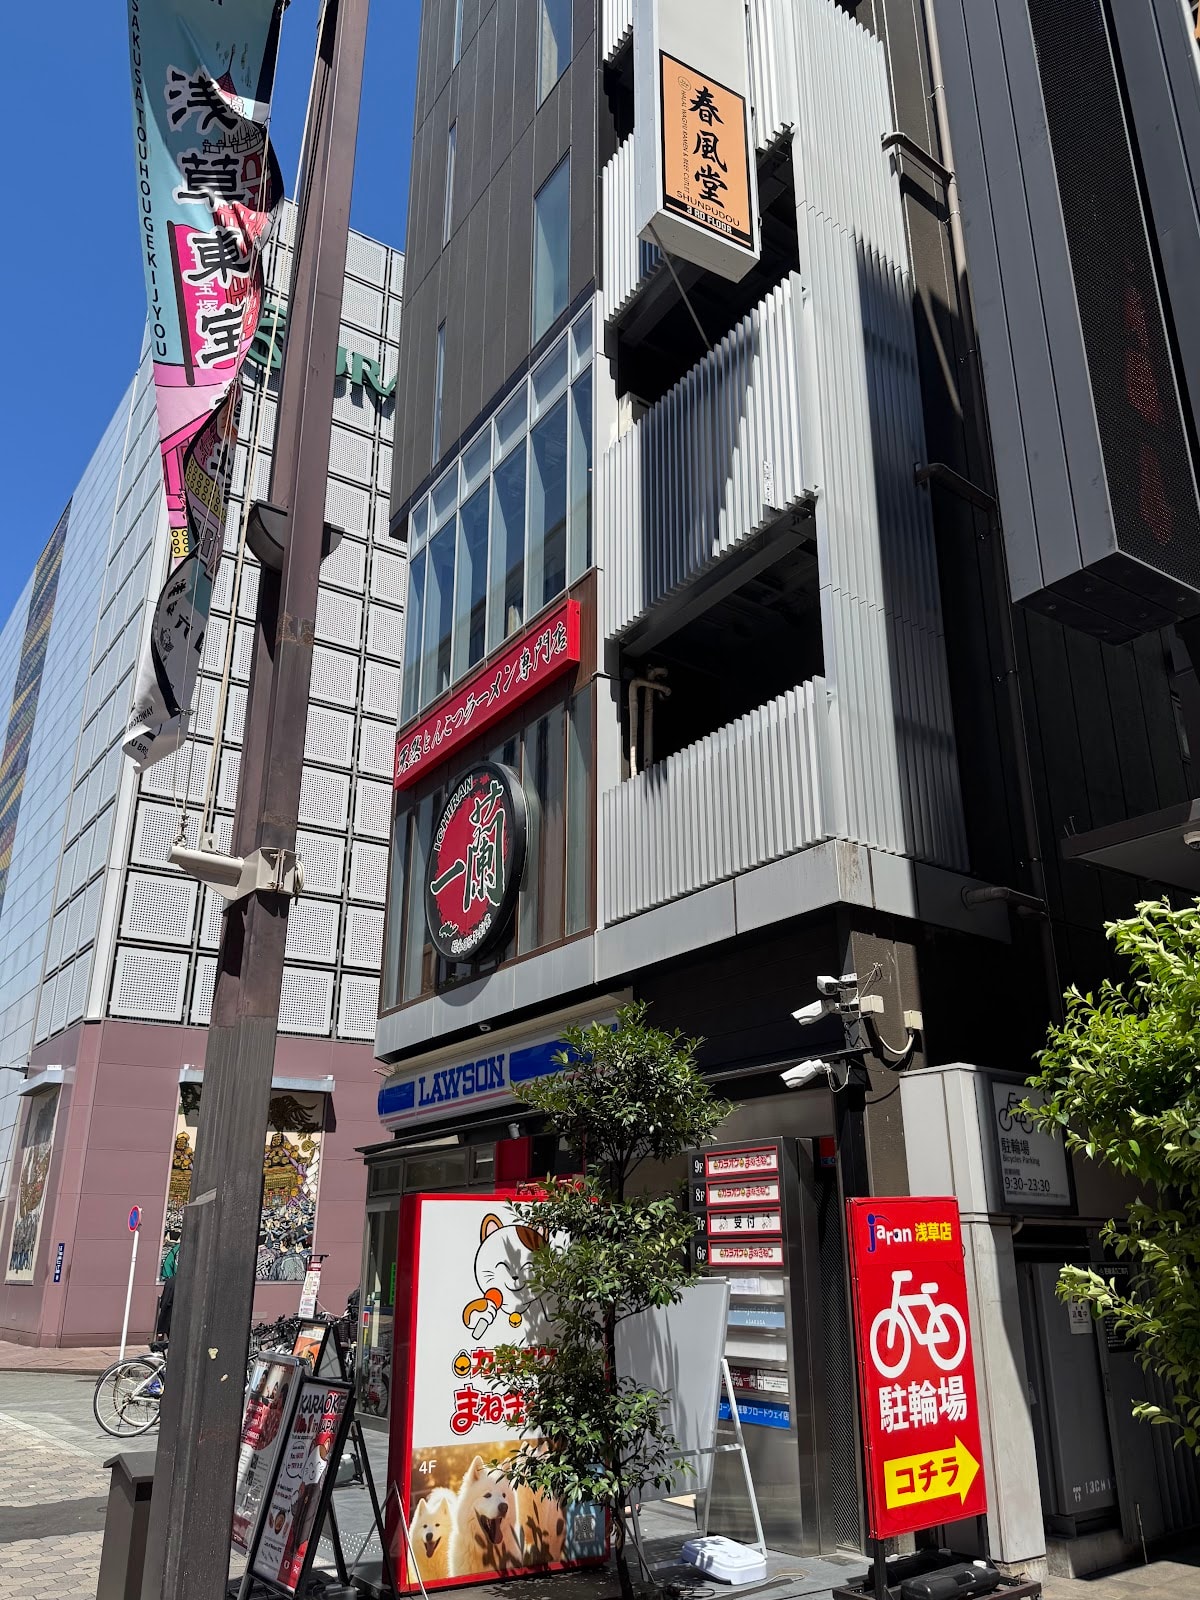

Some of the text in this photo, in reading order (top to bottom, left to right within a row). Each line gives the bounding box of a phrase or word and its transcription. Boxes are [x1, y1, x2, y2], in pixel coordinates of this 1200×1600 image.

[688, 86, 728, 208] 春風堂
[676, 190, 740, 227] SHUNPUDOU
[707, 214, 732, 234] FLOOR
[434, 774, 473, 852] ICHIRAN
[430, 780, 505, 913] 一蘭
[418, 1053, 505, 1108] LAWSON
[694, 1160, 704, 1174] 9F
[1005, 1176, 1051, 1192] 9:30-23:30
[695, 1188, 705, 1202] 8F
[734, 1215, 755, 1229] 受付
[867, 1213, 952, 1253] jaran 浅草店
[697, 1245, 707, 1260] 6F
[879, 1375, 968, 1434] 駐輪場
[419, 1460, 437, 1475] 4F
[896, 1456, 960, 1495] コチラ
